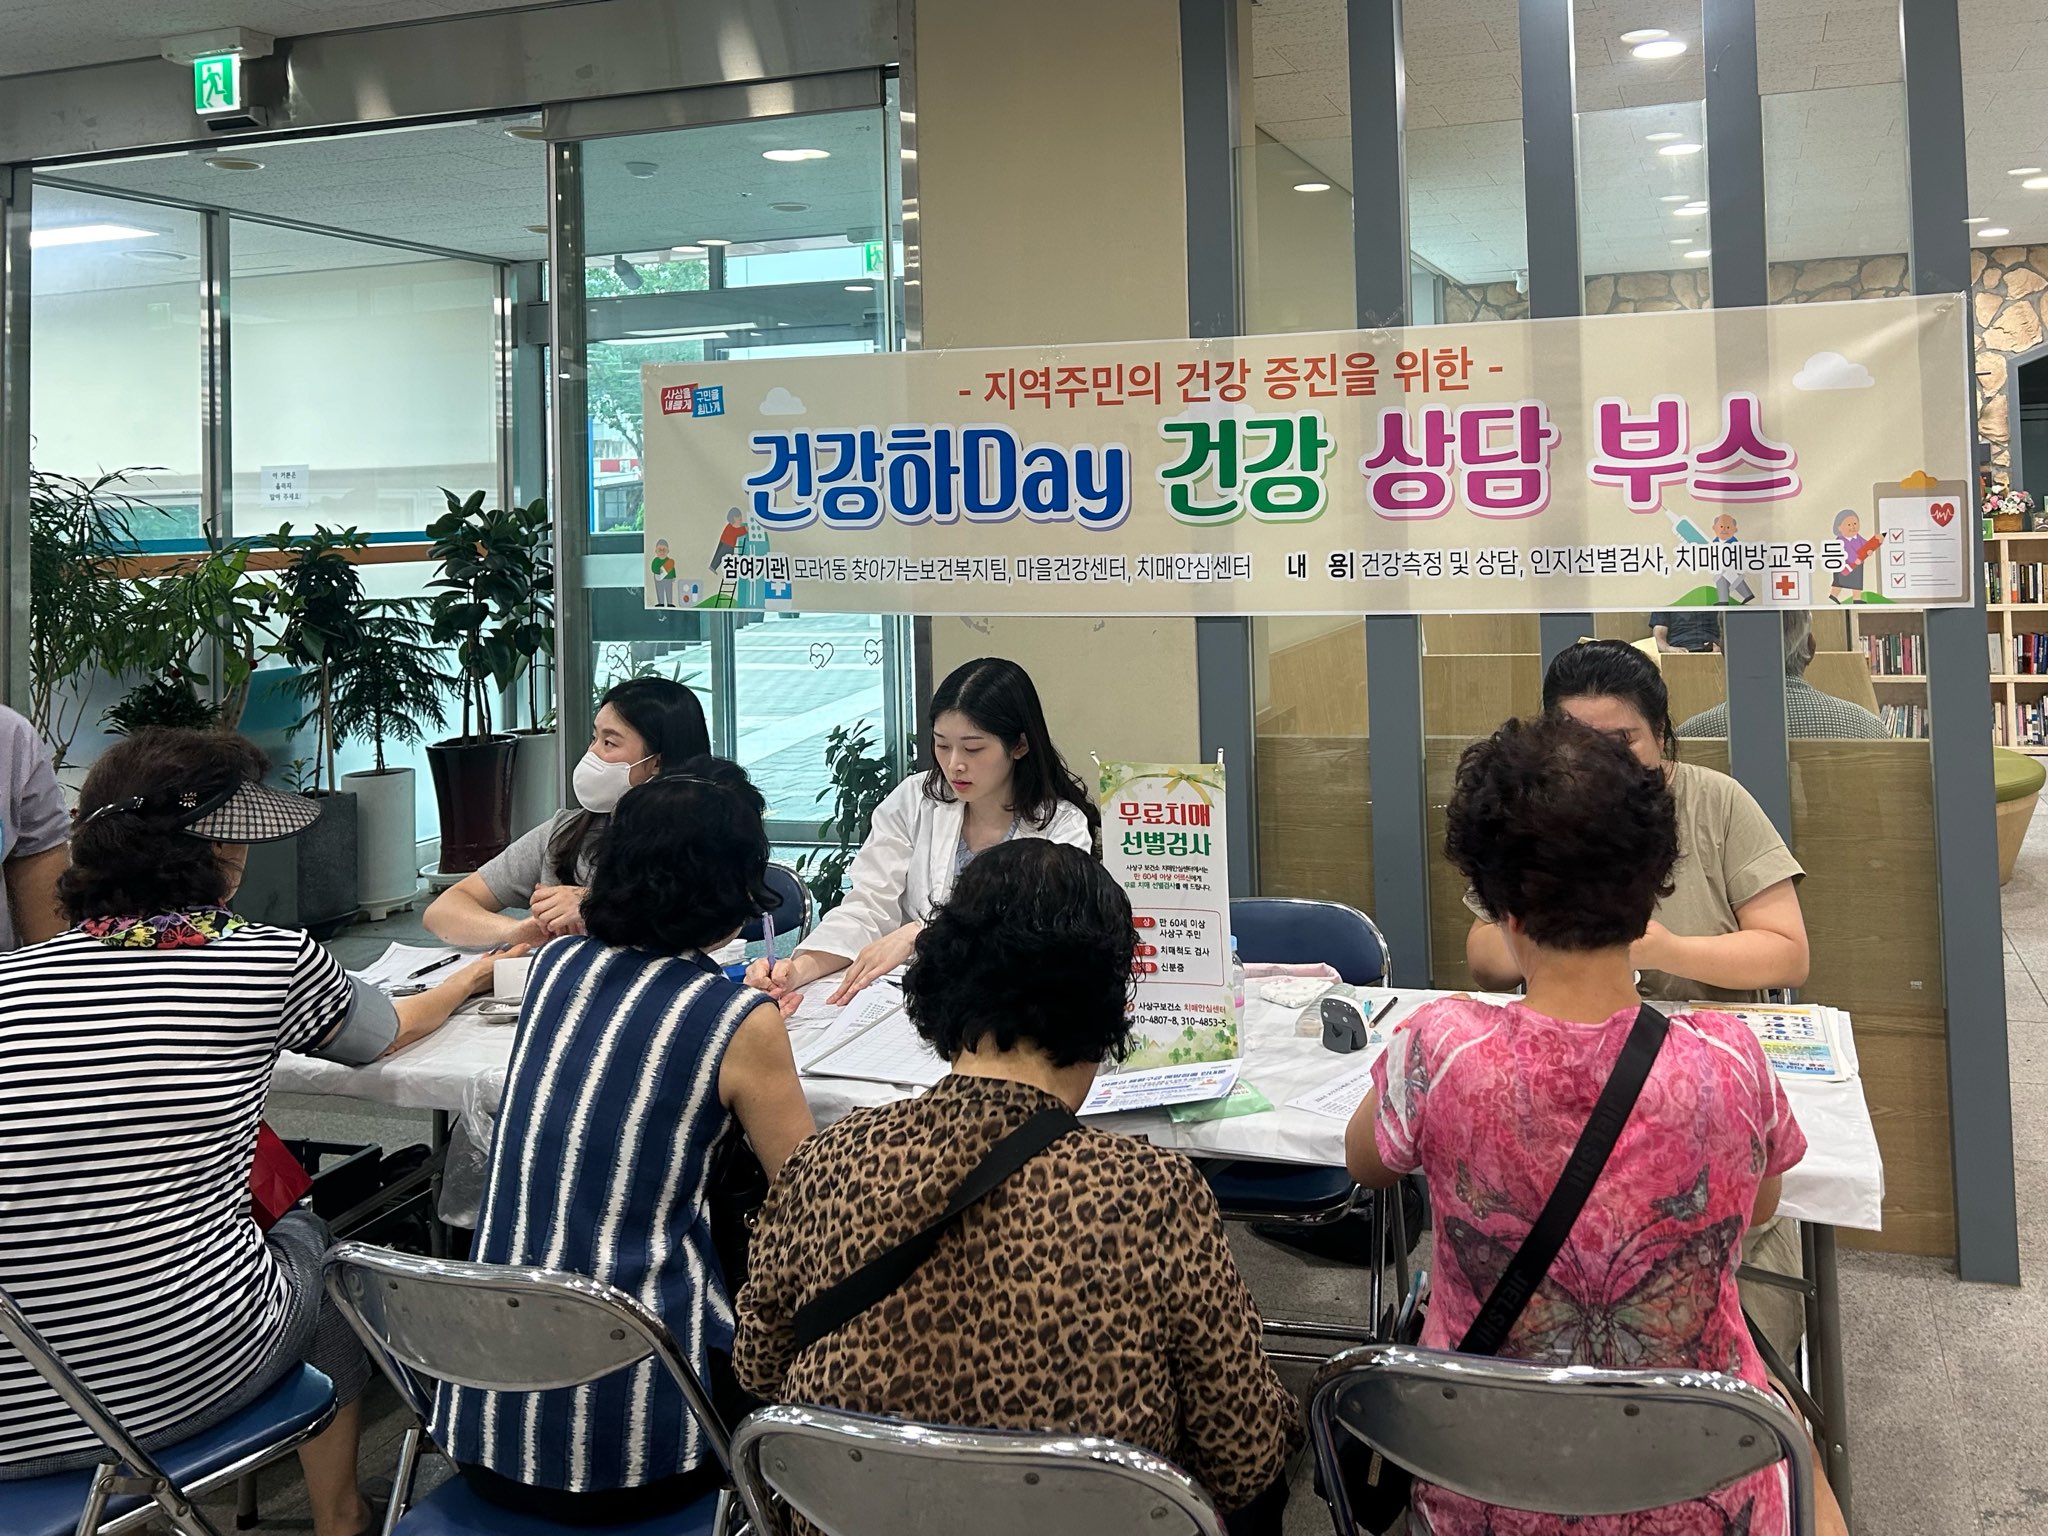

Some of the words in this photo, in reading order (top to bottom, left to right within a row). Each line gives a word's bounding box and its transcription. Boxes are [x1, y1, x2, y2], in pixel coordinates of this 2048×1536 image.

[984, 362, 1162, 410] 지역주민의
[1175, 358, 1252, 403] 건강
[1263, 352, 1380, 400] 증진을
[1394, 346, 1474, 393] 위한
[696, 389, 719, 402] 구민을
[746, 428, 1125, 522] 건강하Day
[1161, 414, 1330, 517] 건강
[1364, 405, 1552, 510] 상담
[1593, 398, 1792, 502] 부스
[1288, 553, 1306, 578] 내
[1361, 551, 1442, 577] 건강측정
[1450, 550, 1469, 576] 및
[1475, 549, 1523, 577] 상담,
[1530, 546, 1669, 575] 인지선별검사,
[1676, 543, 1814, 571] 치매예방교육
[1822, 542, 1845, 570] 등
[794, 558, 847, 581] 모라1동
[852, 557, 1011, 584] 찾아가는보건복지팀,
[1017, 557, 1131, 583] 마을건강센터,
[1137, 555, 1250, 581] 치매안심센터
[1119, 802, 1211, 827] 무료치매
[1120, 831, 1212, 856] 선별검사
[1160, 873, 1172, 881] 이상
[1170, 919, 1187, 928] 60세
[1191, 919, 1205, 929] 이상
[1160, 929, 1183, 938] 사상구
[1186, 930, 1200, 939] 주민
[1160, 946, 1192, 956] 치매척도
[1194, 947, 1210, 956] 검사
[1161, 963, 1184, 972] 신분증
[1139, 1002, 1181, 1012] 사상구보건소
[1184, 1003, 1226, 1014] 치매안심센터
